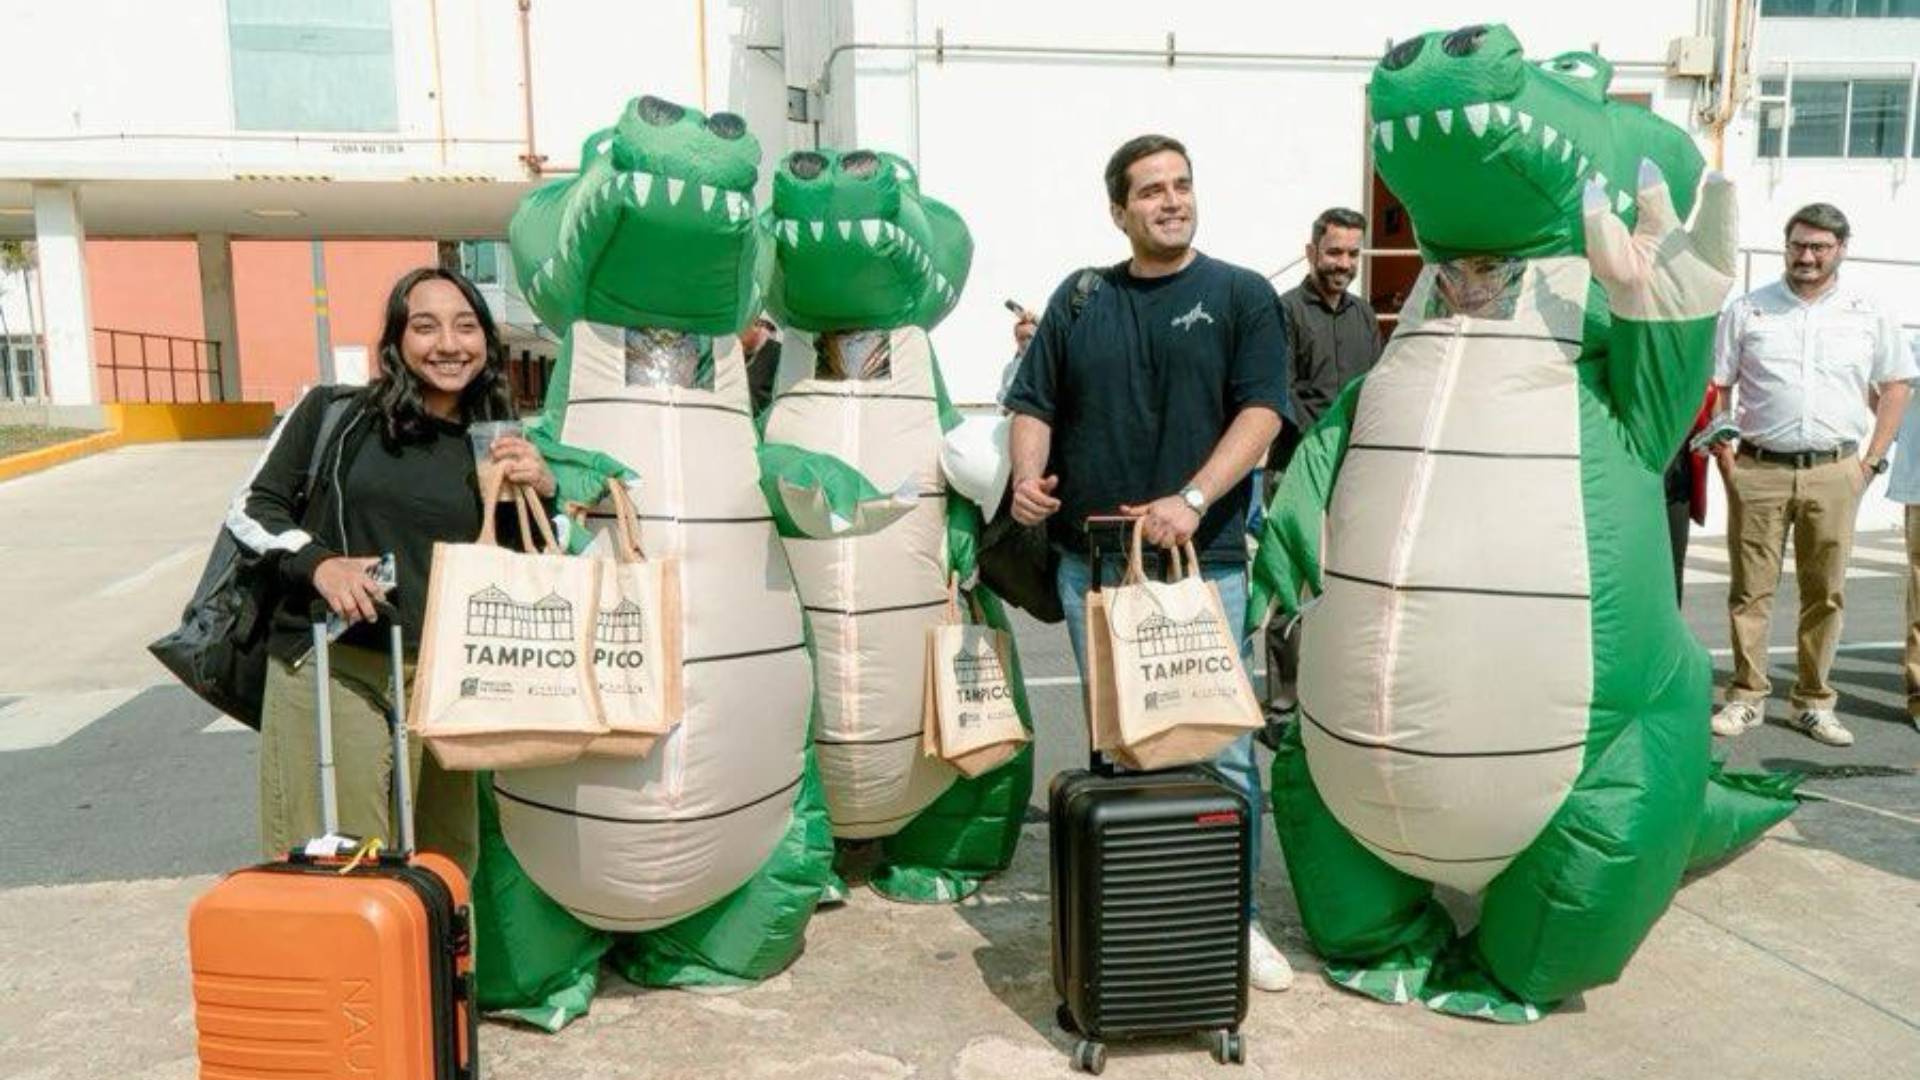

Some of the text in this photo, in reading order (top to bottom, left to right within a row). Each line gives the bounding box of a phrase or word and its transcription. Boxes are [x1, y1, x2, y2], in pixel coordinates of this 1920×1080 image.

[464, 644, 576, 669] TAMPICO
[592, 648, 644, 669] PICO
[1140, 655, 1233, 681] TAMPICO
[340, 976, 377, 1080] NAU
